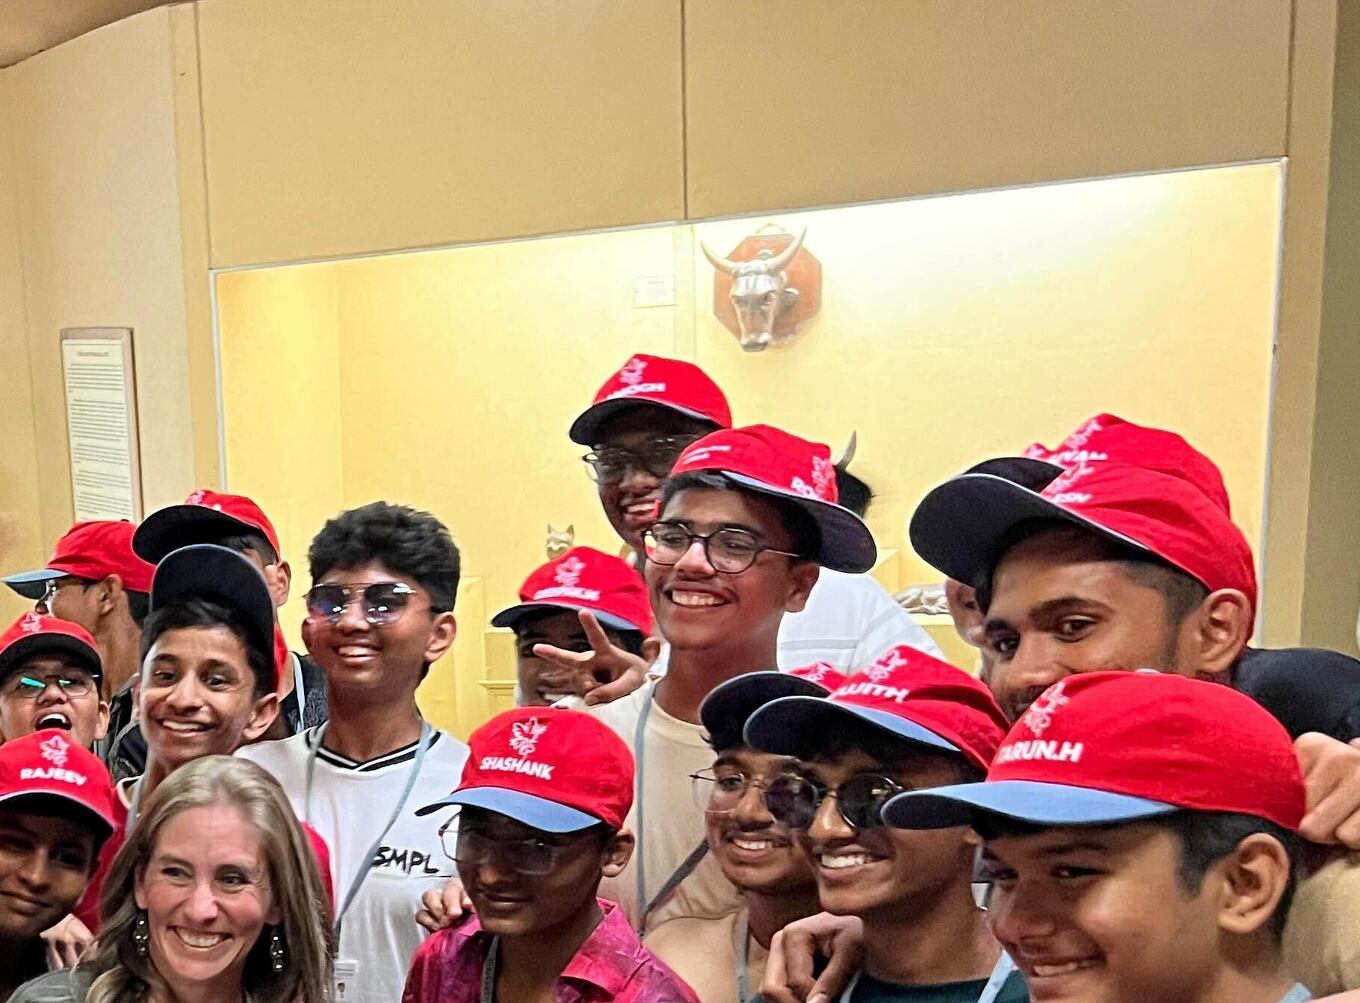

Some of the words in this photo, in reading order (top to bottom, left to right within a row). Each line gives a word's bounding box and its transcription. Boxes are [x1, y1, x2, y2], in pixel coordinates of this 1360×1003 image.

[20, 767, 87, 786] RAJEEV
[479, 756, 556, 780] SHASHANK
[370, 846, 440, 875] SMPL
